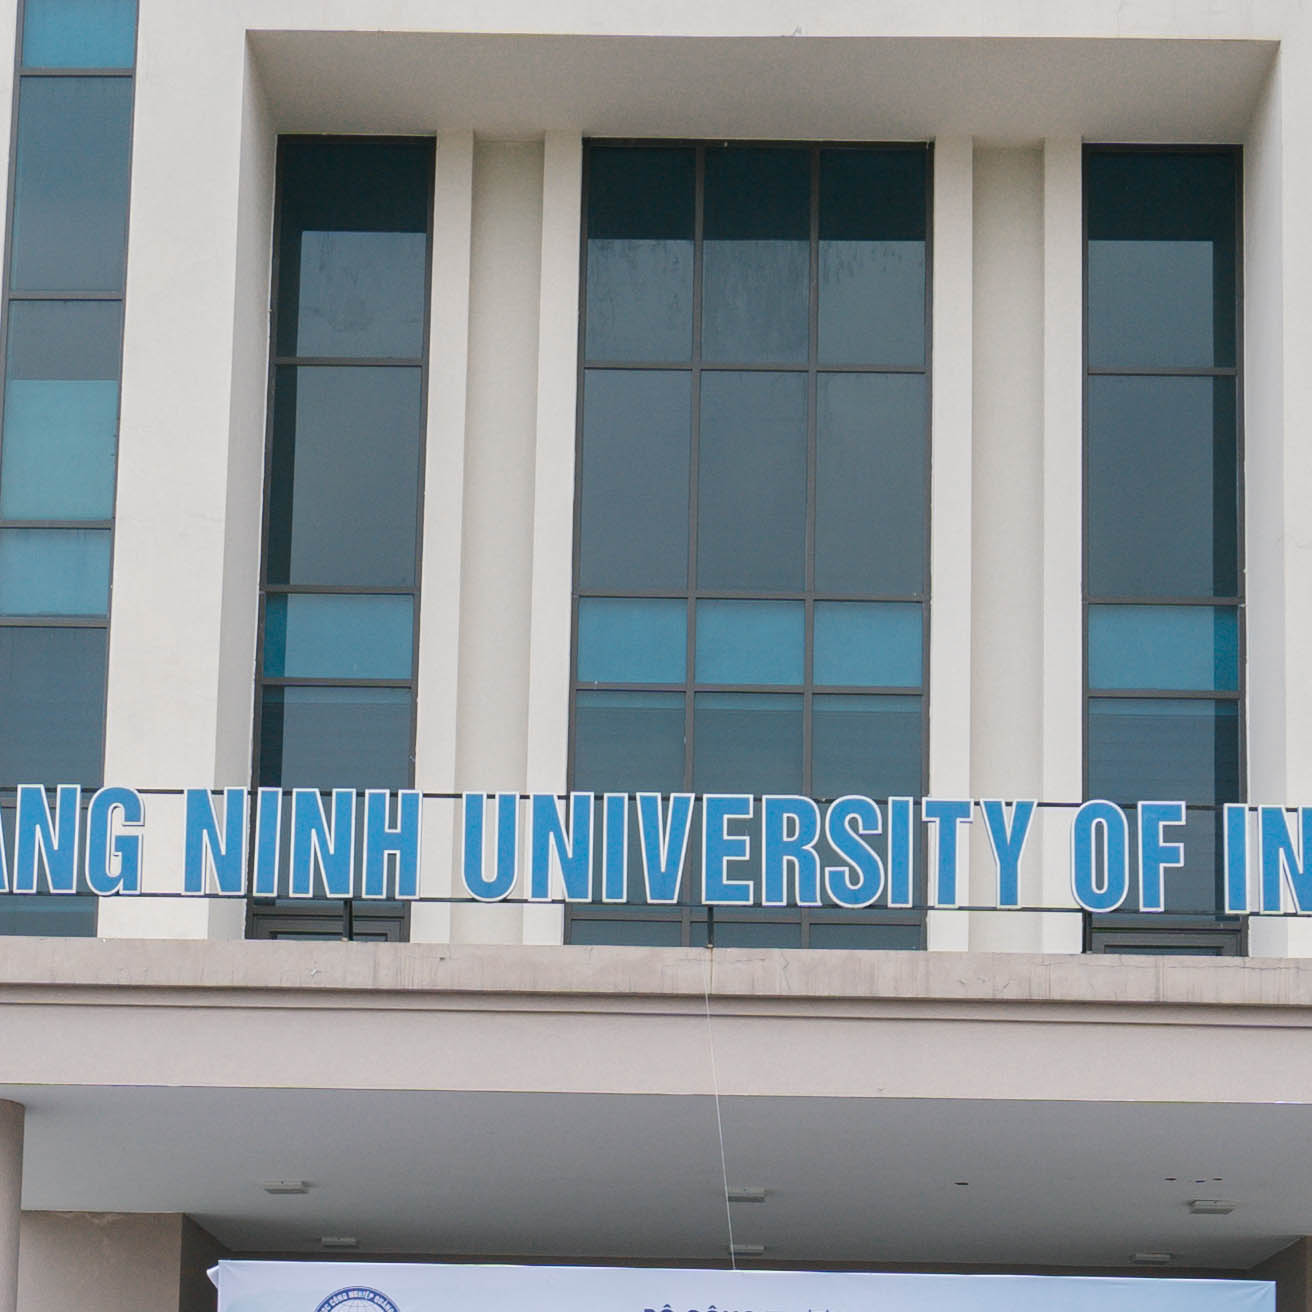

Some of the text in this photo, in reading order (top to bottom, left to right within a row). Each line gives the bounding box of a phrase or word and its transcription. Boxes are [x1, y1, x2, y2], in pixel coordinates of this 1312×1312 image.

[183, 787, 422, 899] NINH
[461, 791, 1038, 908] UNIVERSITY
[1070, 800, 1186, 912] OF
